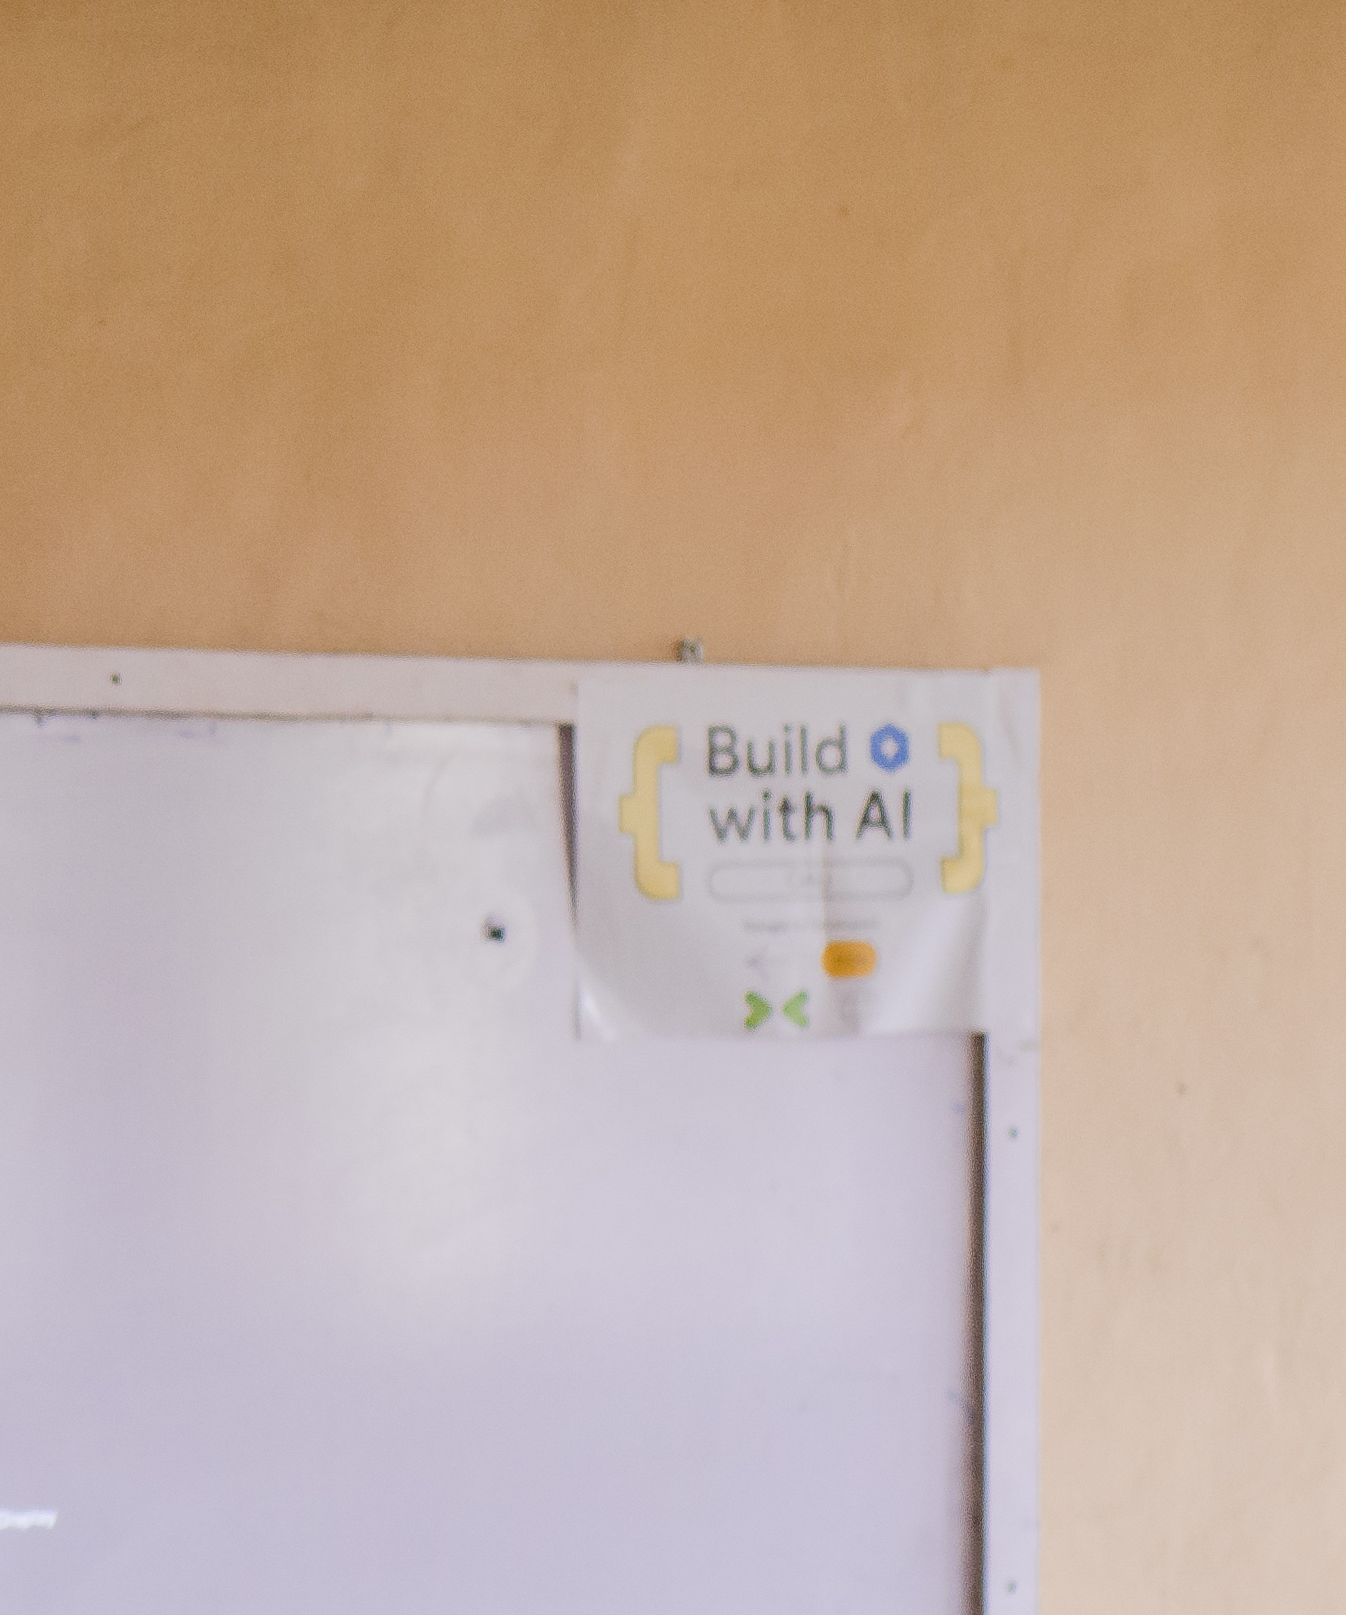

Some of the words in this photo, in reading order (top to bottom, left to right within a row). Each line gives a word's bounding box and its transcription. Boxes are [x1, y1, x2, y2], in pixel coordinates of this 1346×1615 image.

[707, 722, 849, 779] Build
[709, 789, 836, 844] with
[854, 788, 913, 842] AI
